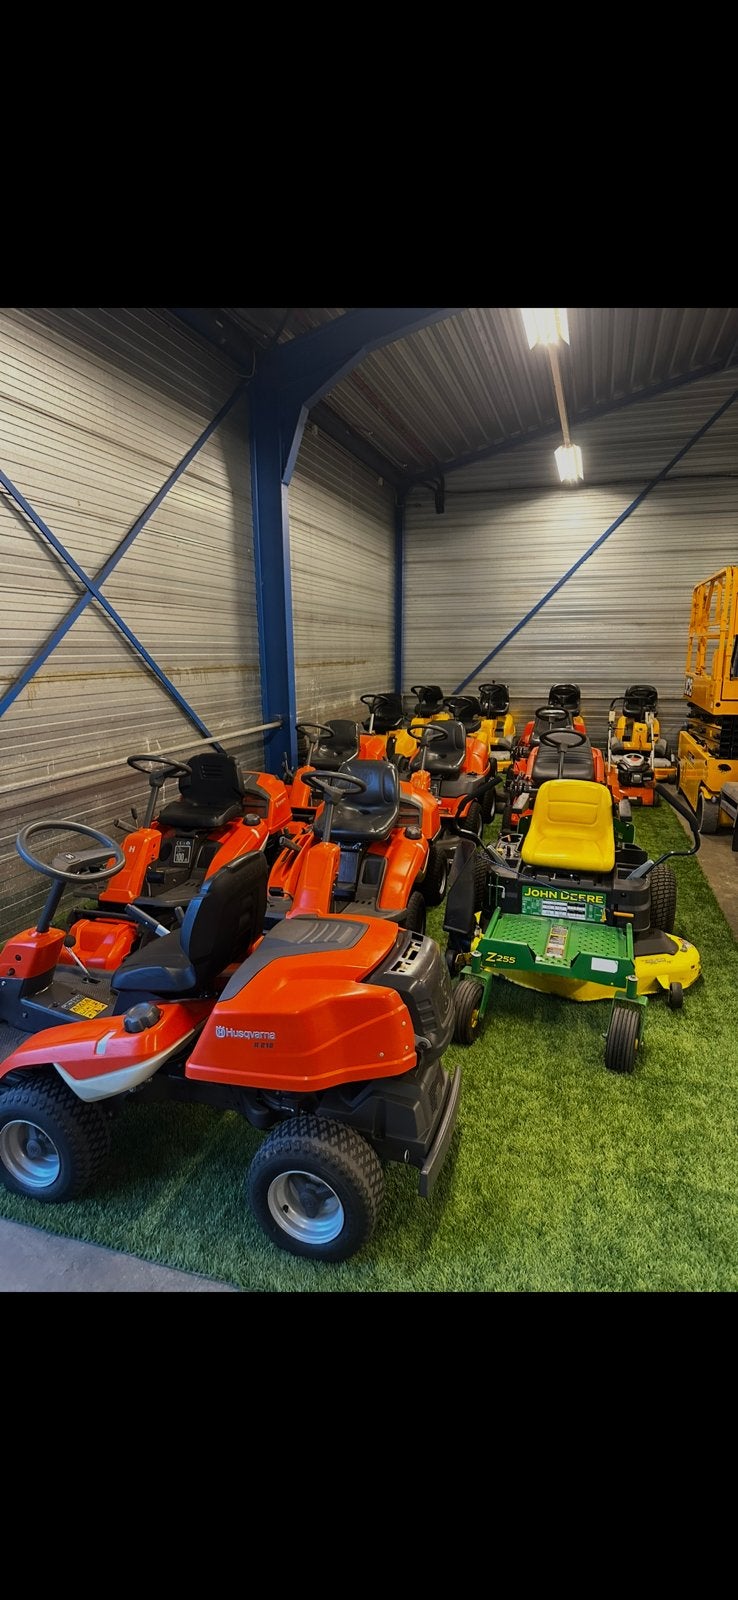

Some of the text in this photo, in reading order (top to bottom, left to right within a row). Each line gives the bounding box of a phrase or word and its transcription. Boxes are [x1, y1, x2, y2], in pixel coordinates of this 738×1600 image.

[524, 887, 604, 904] JOHN DEERE
[485, 951, 516, 964] Z255
[225, 1027, 276, 1040] Husqvarna
